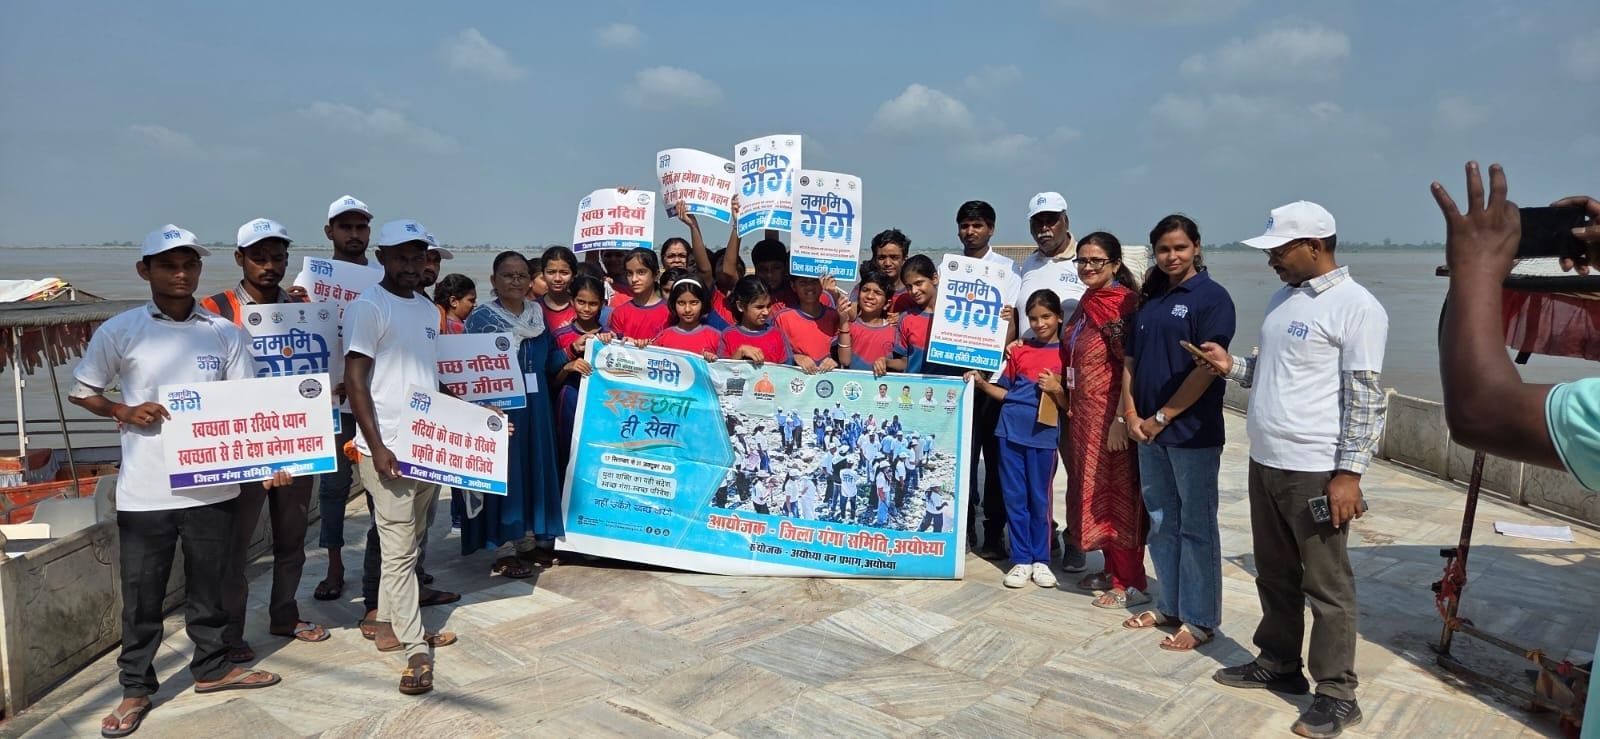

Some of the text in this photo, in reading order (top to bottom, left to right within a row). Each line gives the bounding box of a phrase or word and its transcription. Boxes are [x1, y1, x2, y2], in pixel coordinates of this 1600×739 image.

[741, 153, 778, 172] नमामि
[701, 174, 716, 186] करो
[717, 178, 731, 190] मान
[697, 187, 711, 201] देश
[711, 192, 730, 206] महान
[800, 192, 841, 212] नमामि
[582, 208, 604, 222] स्वच्छ
[581, 222, 645, 238] स्वच्छ जीवन
[333, 283, 341, 299] दो
[947, 279, 989, 299] नमामि
[253, 328, 311, 355] नमामि
[472, 376, 514, 393] जीवन
[603, 389, 698, 418] स्वच्छता
[192, 411, 307, 438] स्वच्छता का रखिये ध्यान
[621, 415, 681, 439] ही सेवा
[411, 419, 496, 454] नदियों को बचा के रखिये
[178, 436, 324, 466] स्वच्छता से ही देश बनेगा महान
[412, 444, 494, 474] प्रकृति की रक्षा कीजिये
[193, 471, 220, 484] जिला
[222, 470, 241, 482] गंगा
[243, 467, 272, 480] समिति
[707, 513, 767, 536] आयोजक
[779, 523, 814, 543] जिला
[817, 529, 846, 547] गंगा
[790, 548, 822, 561] अयोध्या
[823, 551, 837, 563] वन
